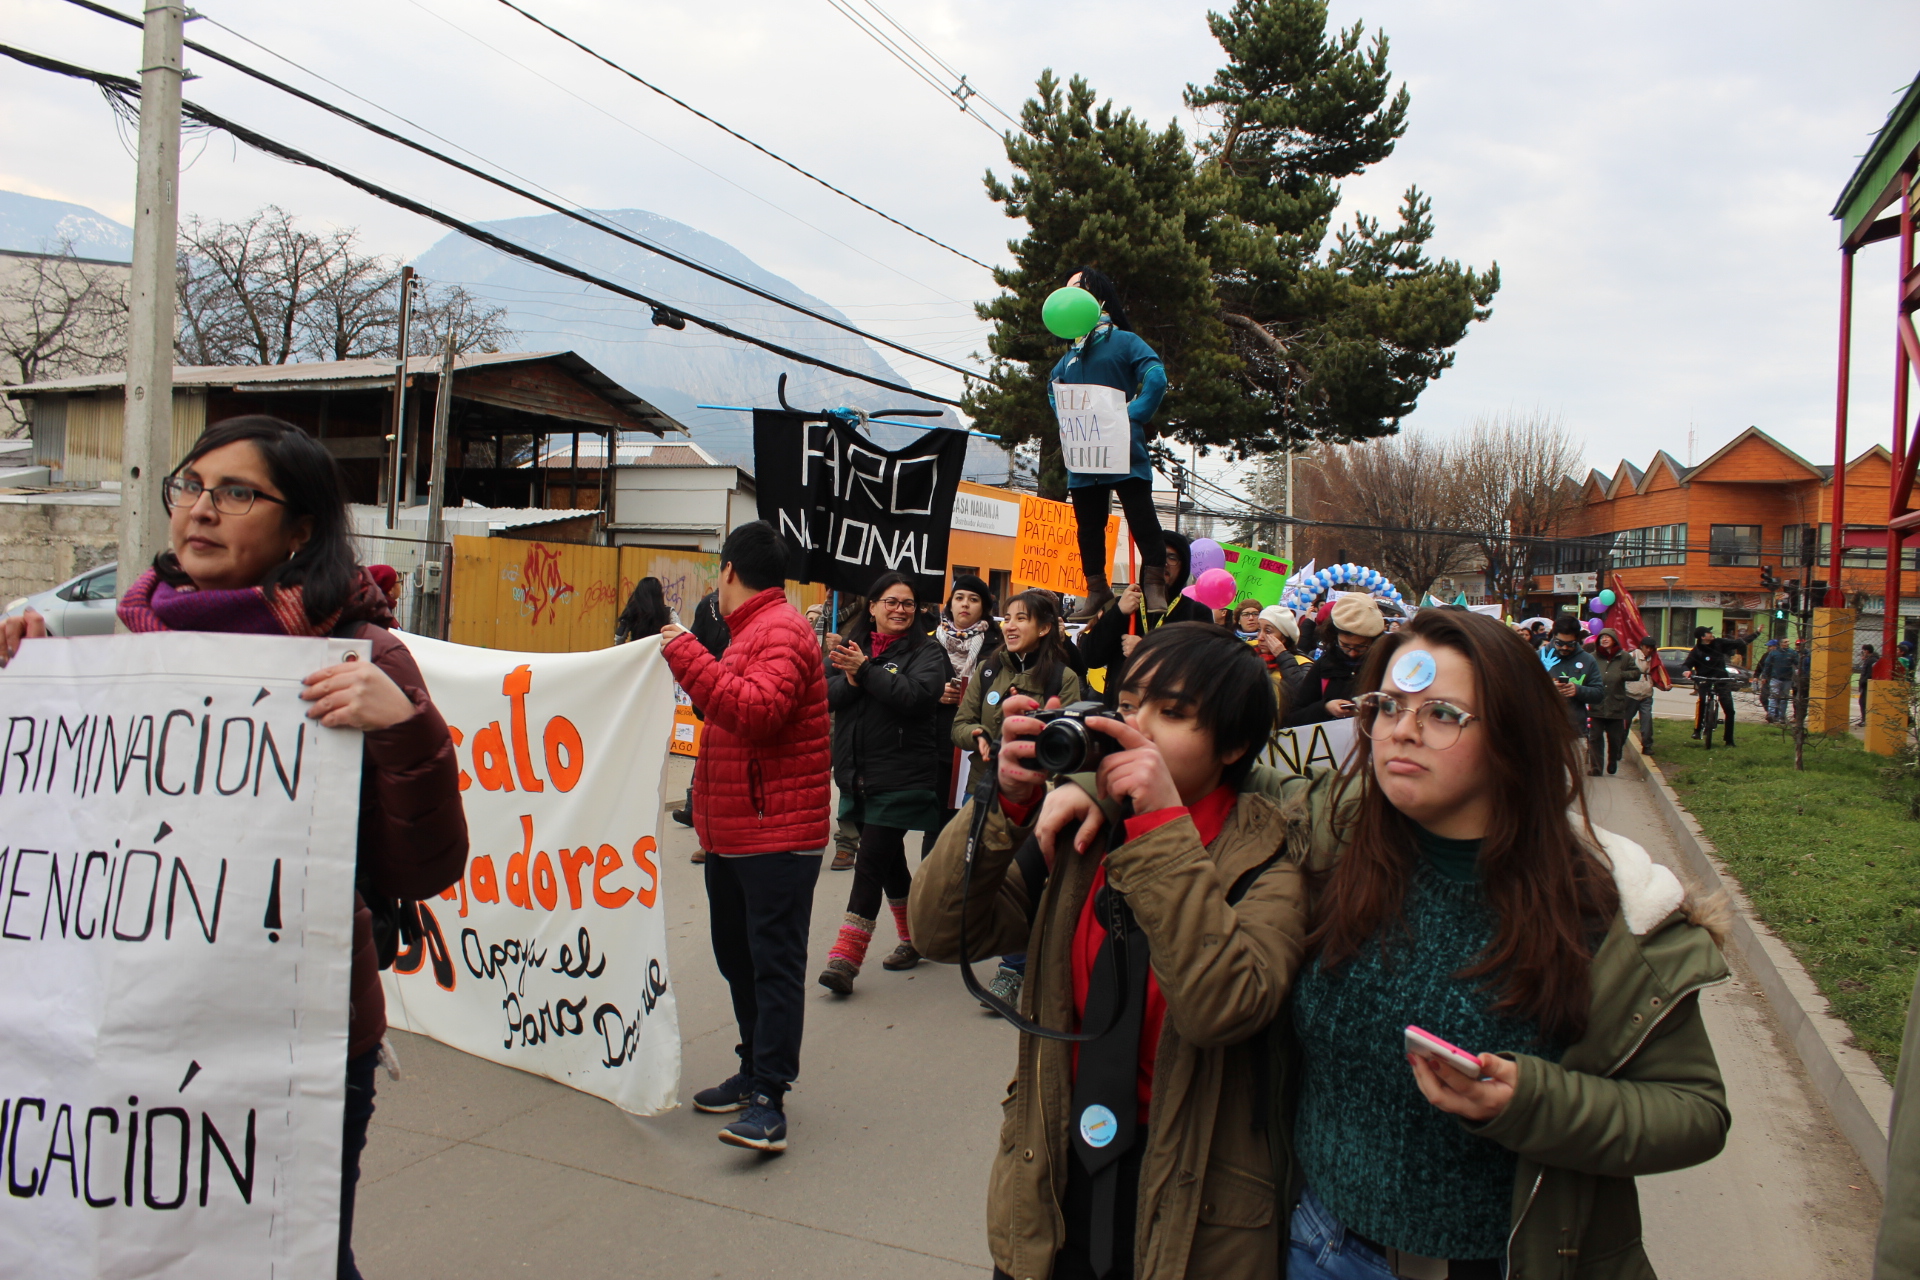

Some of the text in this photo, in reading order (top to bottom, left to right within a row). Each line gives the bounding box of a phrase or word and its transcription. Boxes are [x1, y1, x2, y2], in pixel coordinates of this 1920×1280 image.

[970, 500, 1000, 520] NARANJA
[778, 507, 945, 576] NIONAL
[1023, 544, 1058, 560] unidos
[1019, 558, 1050, 584] PARO
[670, 741, 693, 752] AGO
[1256, 724, 1339, 777] ÑA
[0, 820, 227, 943] ENCIÓN
[438, 814, 658, 918] jadores
[551, 926, 606, 979] el
[502, 991, 588, 1050] Paro
[0, 1060, 256, 1210] CACIÓN
